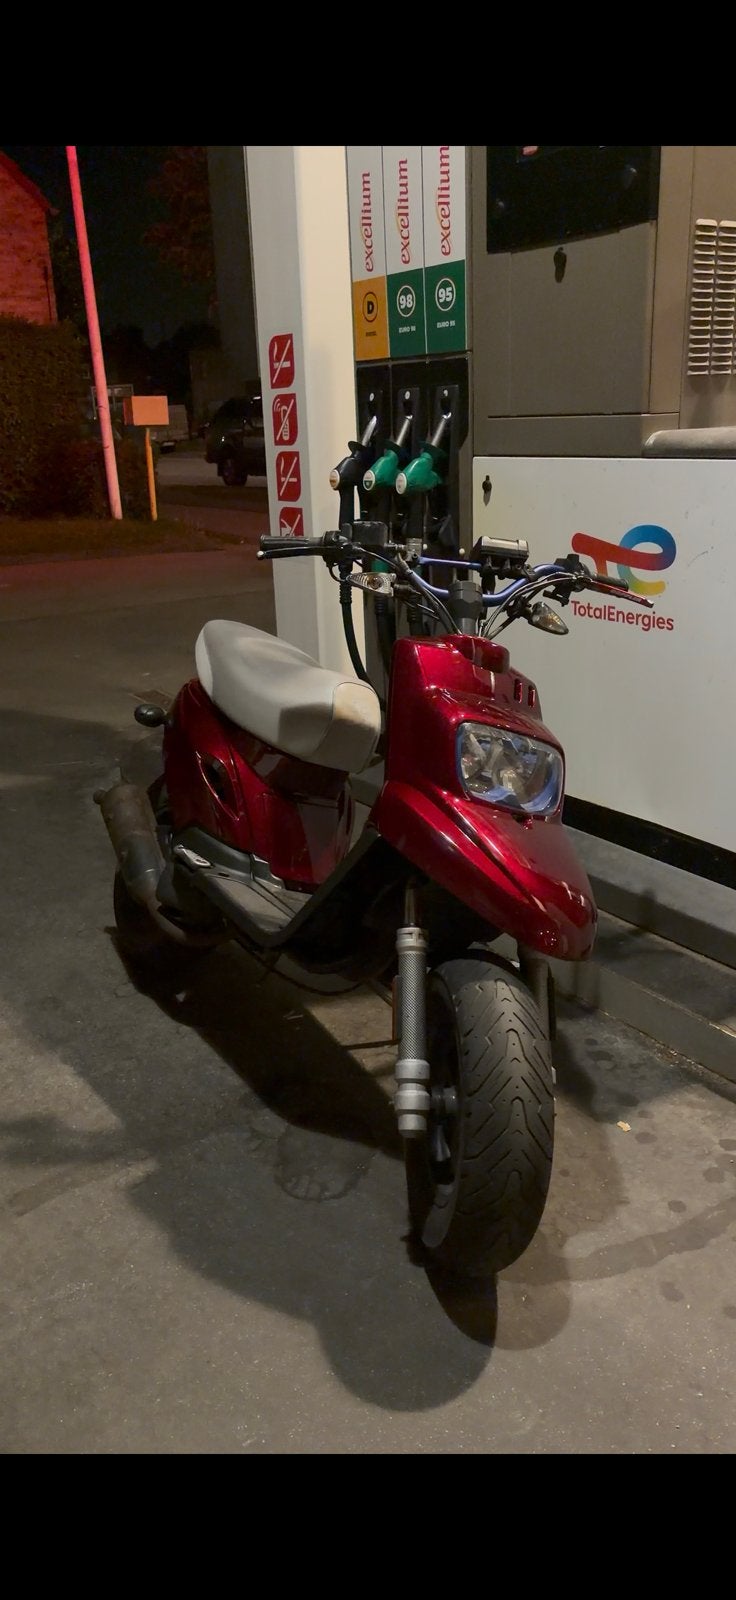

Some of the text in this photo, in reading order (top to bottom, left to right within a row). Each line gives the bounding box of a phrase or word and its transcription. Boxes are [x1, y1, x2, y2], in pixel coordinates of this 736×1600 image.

[397, 159, 411, 265] excellium
[437, 146, 451, 256] excellium
[361, 172, 374, 272] excellium
[367, 301, 374, 314] D
[400, 294, 413, 309] 98
[438, 287, 452, 302] 95
[571, 600, 674, 631] TotalEnergies
